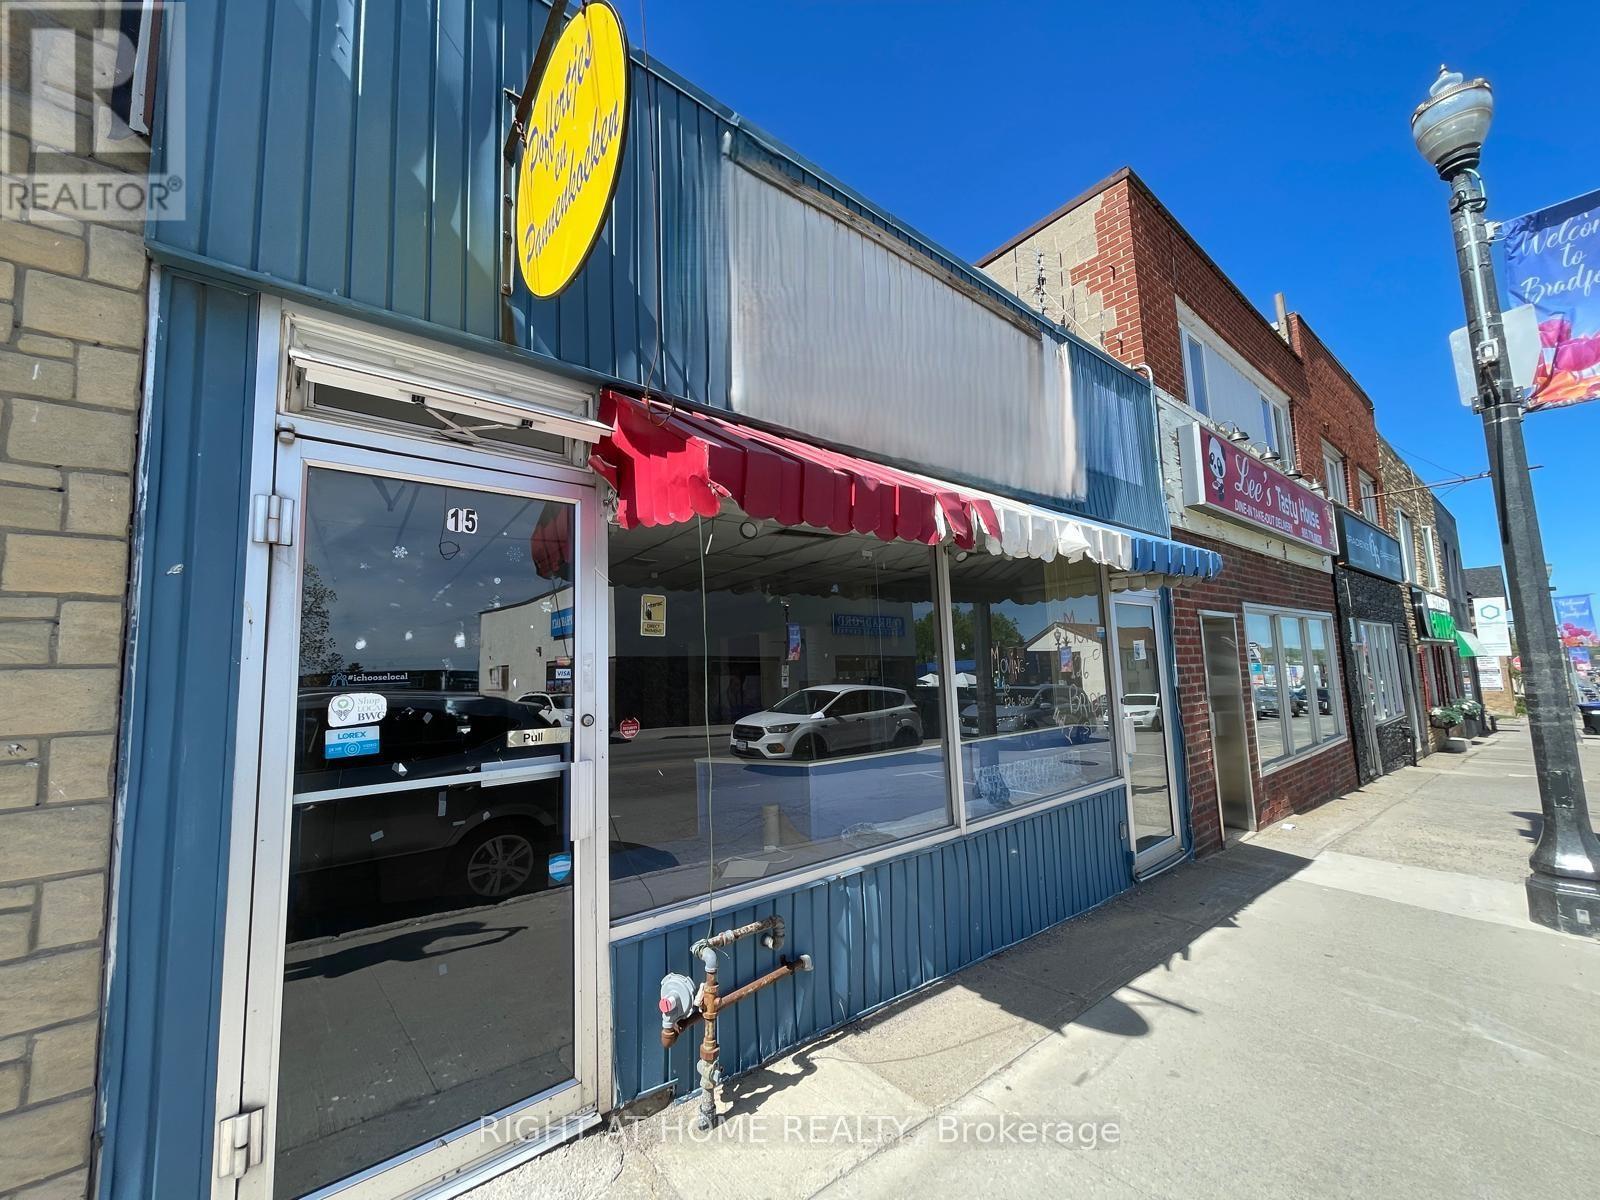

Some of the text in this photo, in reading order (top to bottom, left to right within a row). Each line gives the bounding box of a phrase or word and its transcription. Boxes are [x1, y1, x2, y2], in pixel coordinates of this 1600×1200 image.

[527, 28, 593, 188] Poffertjes
[555, 140, 568, 182] en
[1560, 242, 1587, 267] to
[1234, 453, 1272, 507] Lee's
[1275, 485, 1299, 524] Tasty
[450, 508, 477, 532] 15
[347, 672, 409, 682] #ichooselocal
[357, 696, 381, 706] Shop
[337, 731, 367, 740] LOREX
[523, 732, 544, 743] Pull
